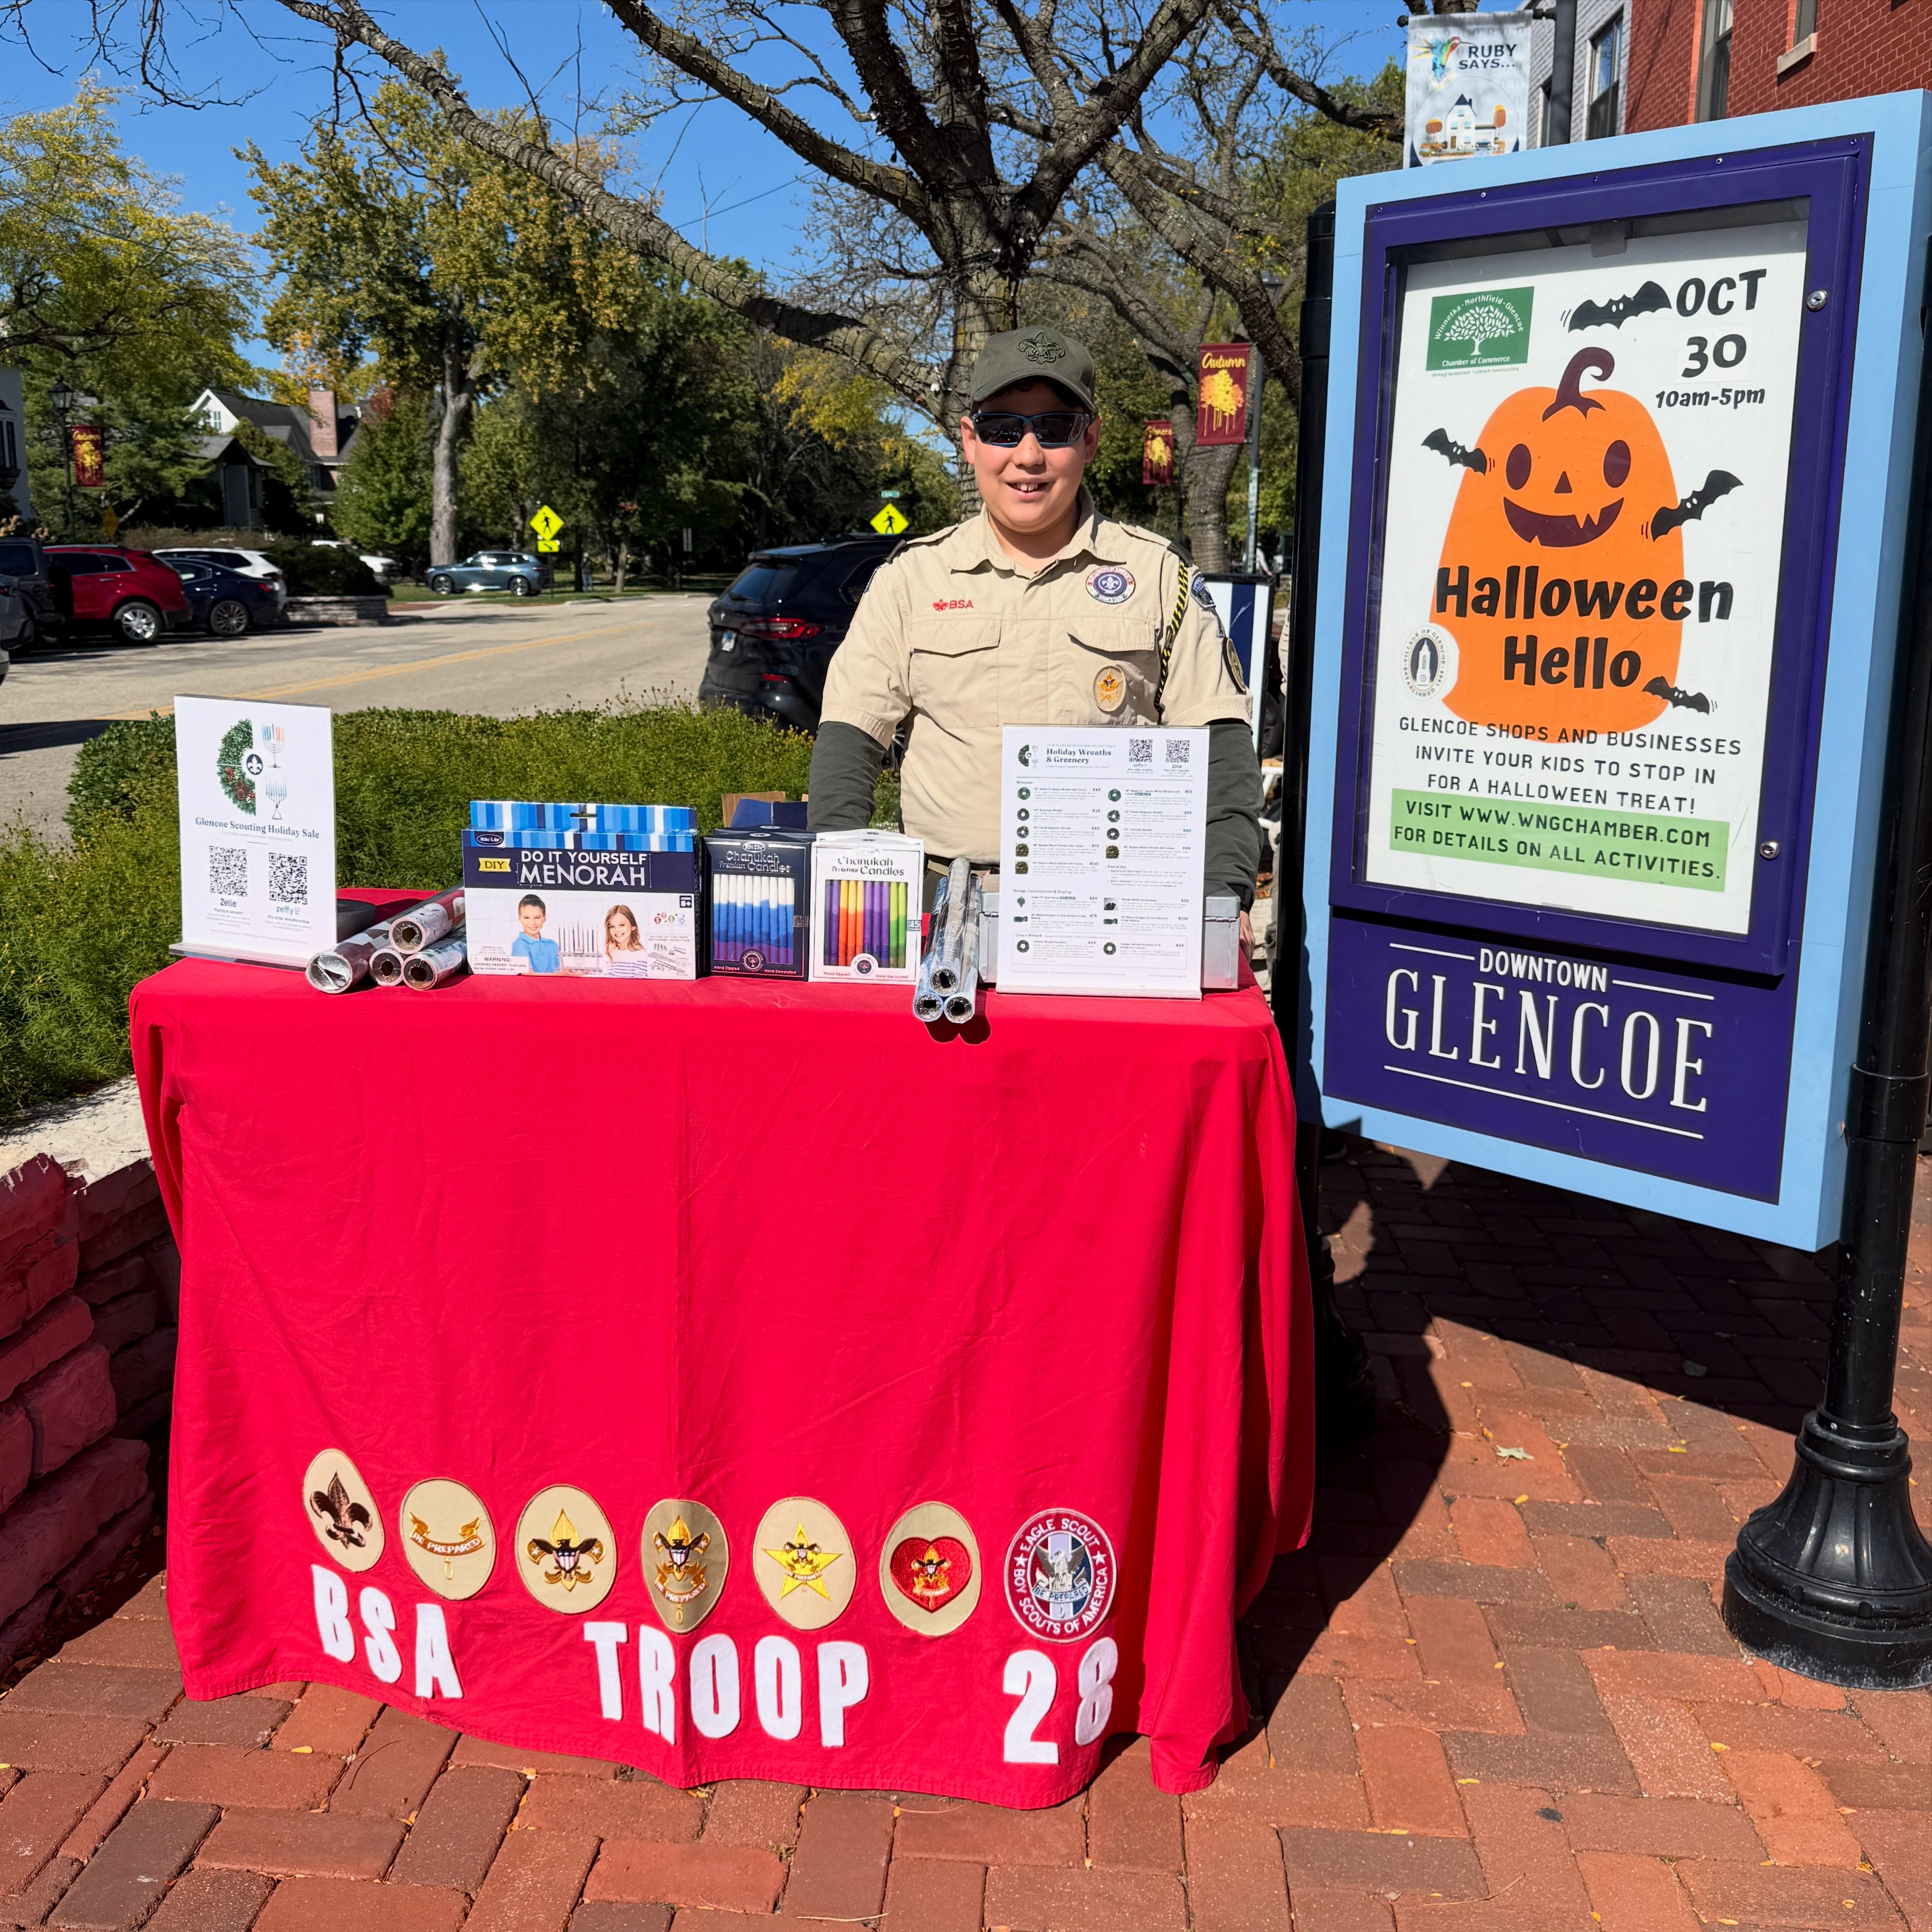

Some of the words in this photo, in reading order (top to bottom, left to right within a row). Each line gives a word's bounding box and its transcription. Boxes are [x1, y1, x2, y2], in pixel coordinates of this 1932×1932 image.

[1468, 44, 1517, 58] RUBY
[1459, 59, 1515, 69] SAYS...
[1677, 269, 1767, 317] OCT
[1434, 306, 1461, 340] Winnetka
[1465, 294, 1503, 306] Northfield
[1505, 302, 1524, 332] Glencoe
[1202, 352, 1245, 369] Autumn
[1682, 334, 1747, 378] 30
[1656, 388, 1765, 409] 10am-5pm
[949, 599, 973, 609] BSA
[1436, 565, 1733, 623] Halloween
[1503, 635, 1641, 690] Hello
[1399, 717, 1479, 736] GLENCOE
[1486, 723, 1549, 741] SHOPS
[1557, 727, 1598, 744] AND
[1607, 731, 1741, 755] BUSINESSES
[1415, 745, 1475, 764] INVITE
[1483, 751, 1532, 769] YOUR
[1541, 756, 1585, 773] KIDS
[1594, 759, 1620, 776] TO
[1629, 763, 1686, 782] STOP
[1695, 768, 1715, 785] IN
[1428, 774, 1460, 790] FOR
[1469, 778, 1479, 792] A
[1488, 780, 1608, 804] HALLOWEEN
[1617, 791, 1695, 814] TREAT!
[196, 817, 228, 828] Glencoe
[230, 821, 266, 834] Scouting
[268, 825, 300, 837] Holiday
[302, 829, 319, 838] Sale
[1406, 800, 1452, 818] VISIT
[1459, 806, 1710, 847] WWW.WNGCHAMBER.COM
[521, 851, 544, 862] DO
[549, 851, 562, 863] IT
[567, 852, 647, 865] YOURSELF
[726, 851, 779, 863] Chanukah
[838, 857, 893, 866] Chanukah
[1394, 826, 1426, 842] FOR
[1433, 830, 1508, 853] DETAILS
[1517, 841, 1541, 857] ON
[1550, 845, 1585, 862] ALL
[1594, 850, 1721, 879] ACTIVITIES.
[520, 863, 646, 887] MENORAH
[747, 862, 792, 873] Candles
[861, 866, 904, 876] Candles
[220, 898, 237, 907] Zelle
[276, 906, 294, 915] zeffy
[1480, 948, 1607, 993] DOWNTOWN
[1385, 968, 1712, 1112] GLENCOE
[413, 1532, 425, 1544] BE
[427, 1538, 481, 1553] PREPARED
[1020, 1518, 1055, 1552] EAGLE
[1061, 1518, 1100, 1547] SCOUT
[1014, 1568, 1027, 1594] BOY
[1035, 1587, 1045, 1597] BE
[1048, 1587, 1088, 1601] PREPARED
[1081, 1566, 1107, 1626] AMERICA
[1019, 1597, 1061, 1634] SCOUTS
[1064, 1621, 1079, 1633] OF
[311, 1564, 463, 1698] BSA
[584, 1622, 869, 1748] TROOP
[1002, 1636, 1118, 1764] 28
